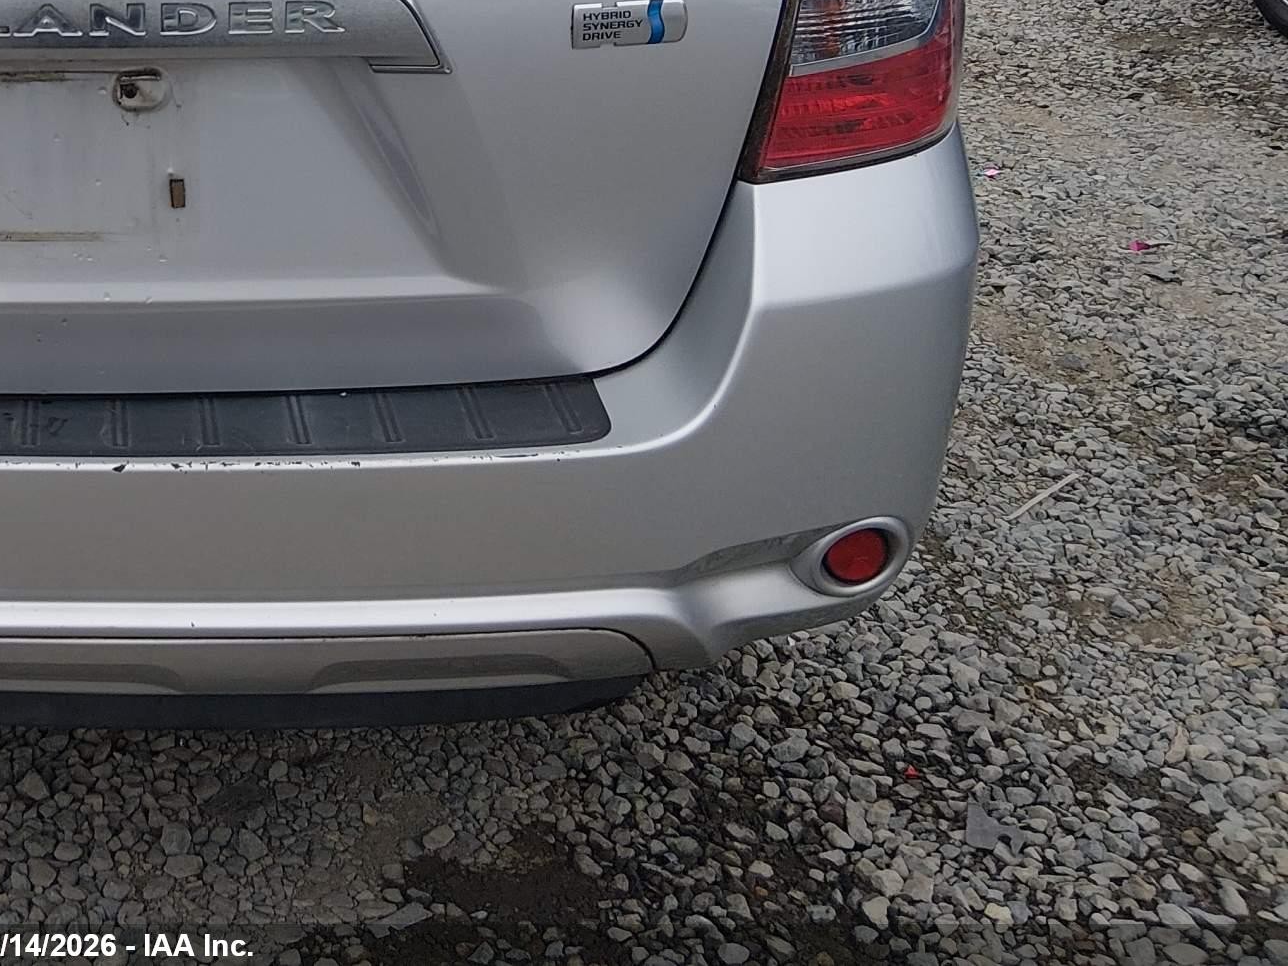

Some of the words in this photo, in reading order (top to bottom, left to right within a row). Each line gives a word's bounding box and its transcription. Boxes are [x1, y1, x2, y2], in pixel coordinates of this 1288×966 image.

[582, 10, 632, 22] HYBRID
[582, 19, 644, 32] SYNERGY
[582, 30, 623, 42] DRIVE
